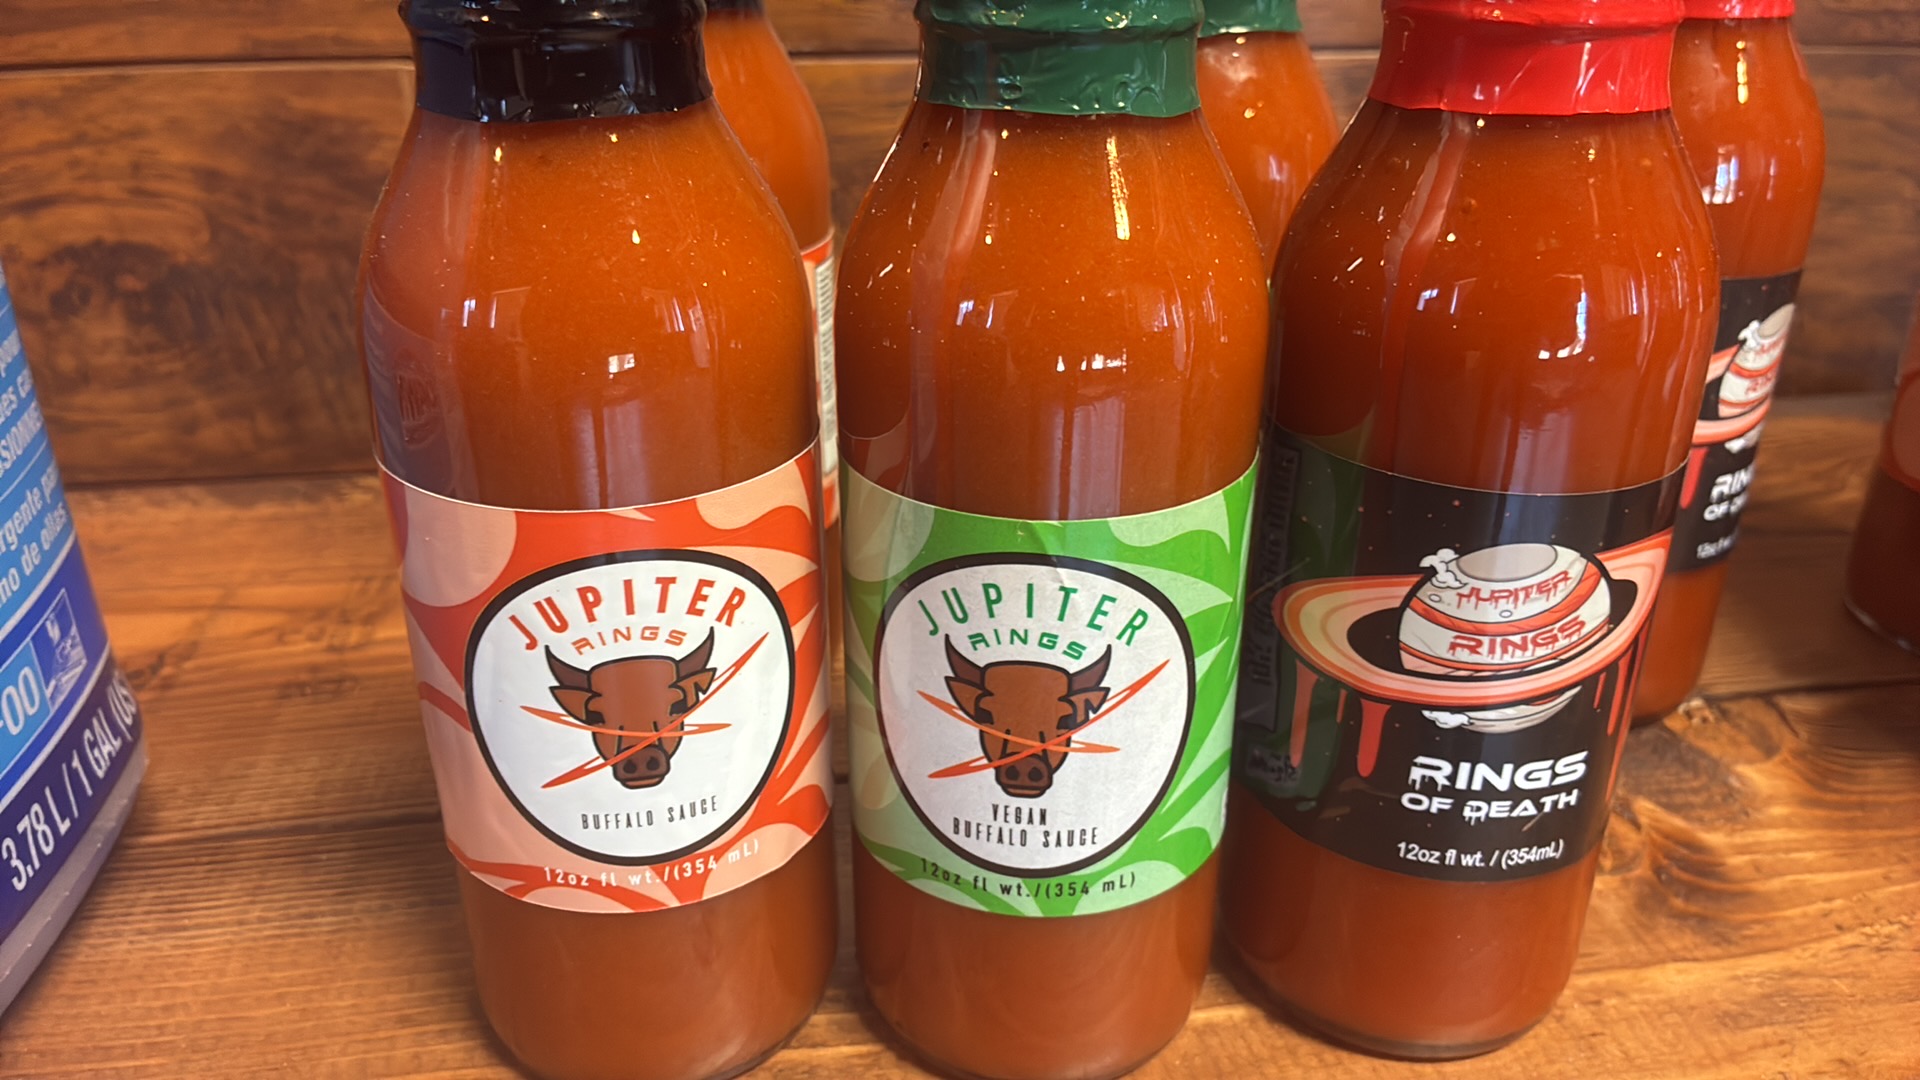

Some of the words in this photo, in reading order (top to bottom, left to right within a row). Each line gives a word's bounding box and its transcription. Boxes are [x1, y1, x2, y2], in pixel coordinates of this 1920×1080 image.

[21, 541, 41, 576] de
[1456, 570, 1573, 610] JUPITER
[509, 576, 746, 650] JUPITER
[918, 583, 1149, 646] JUPITER
[571, 625, 687, 655] RINGS
[967, 629, 1087, 660] RINGS
[1449, 615, 1586, 661] RINGS
[1407, 751, 1589, 792] RINGS
[3, 802, 54, 892] 3.78
[45, 785, 71, 836] L
[62, 762, 79, 818] /
[71, 749, 93, 796] 1
[83, 706, 122, 779] GAL
[581, 809, 654, 830] BUFFALO
[667, 795, 718, 823] SAUCE
[992, 803, 1047, 826] VEGAN
[1401, 792, 1454, 814] OF
[1462, 788, 1579, 826] DEATH
[953, 817, 1028, 848] BUFFALO
[1042, 827, 1099, 848] SAUCE
[545, 866, 590, 886] 12oz
[601, 871, 617, 886] fl
[727, 839, 759, 864] mL)
[1397, 842, 1440, 865] 12oz
[1445, 849, 1456, 866] fl
[1460, 852, 1485, 867] wt.
[1501, 839, 1565, 870] (354mL)
[920, 858, 962, 885] 12oz
[973, 875, 988, 892] fl
[1102, 872, 1136, 892] mL)
